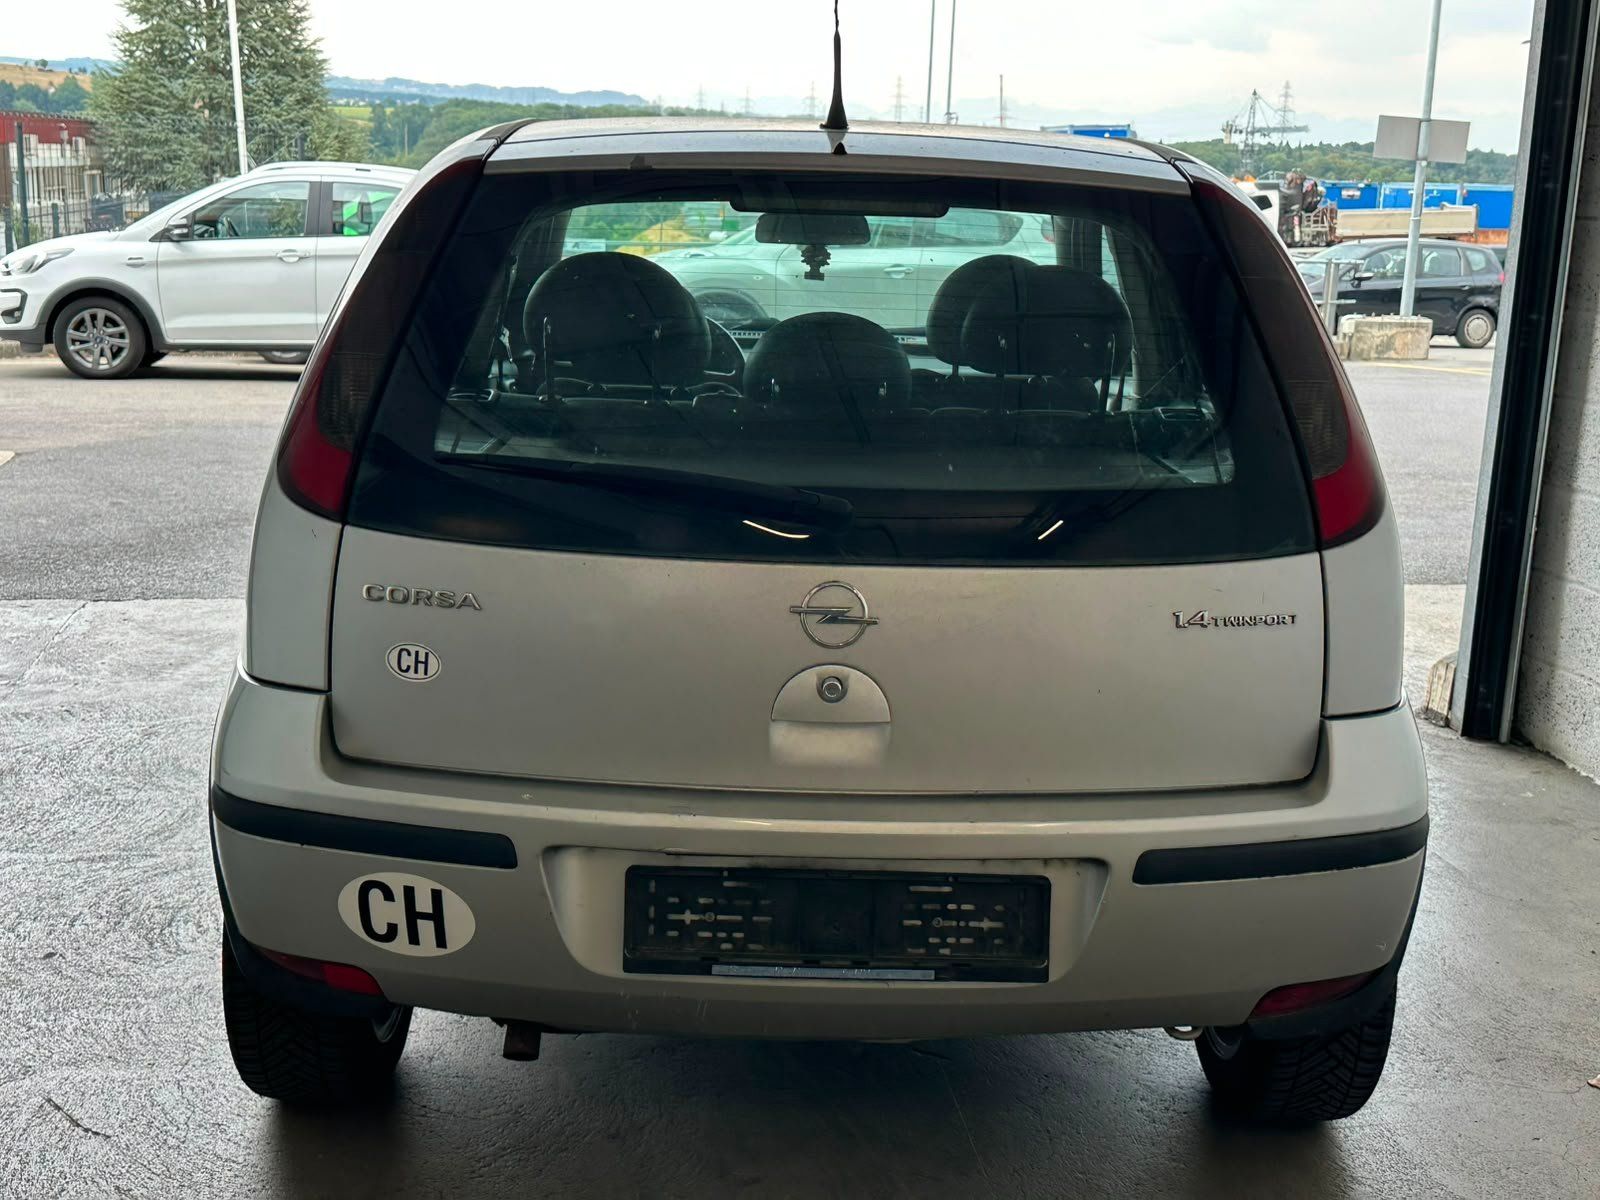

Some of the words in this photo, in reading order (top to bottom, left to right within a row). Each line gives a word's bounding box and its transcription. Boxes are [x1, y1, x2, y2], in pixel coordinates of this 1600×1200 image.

[362, 583, 482, 611] CORSA
[1211, 614, 1297, 628] TWINPORT
[396, 647, 430, 676] CH
[357, 879, 448, 950] CH
